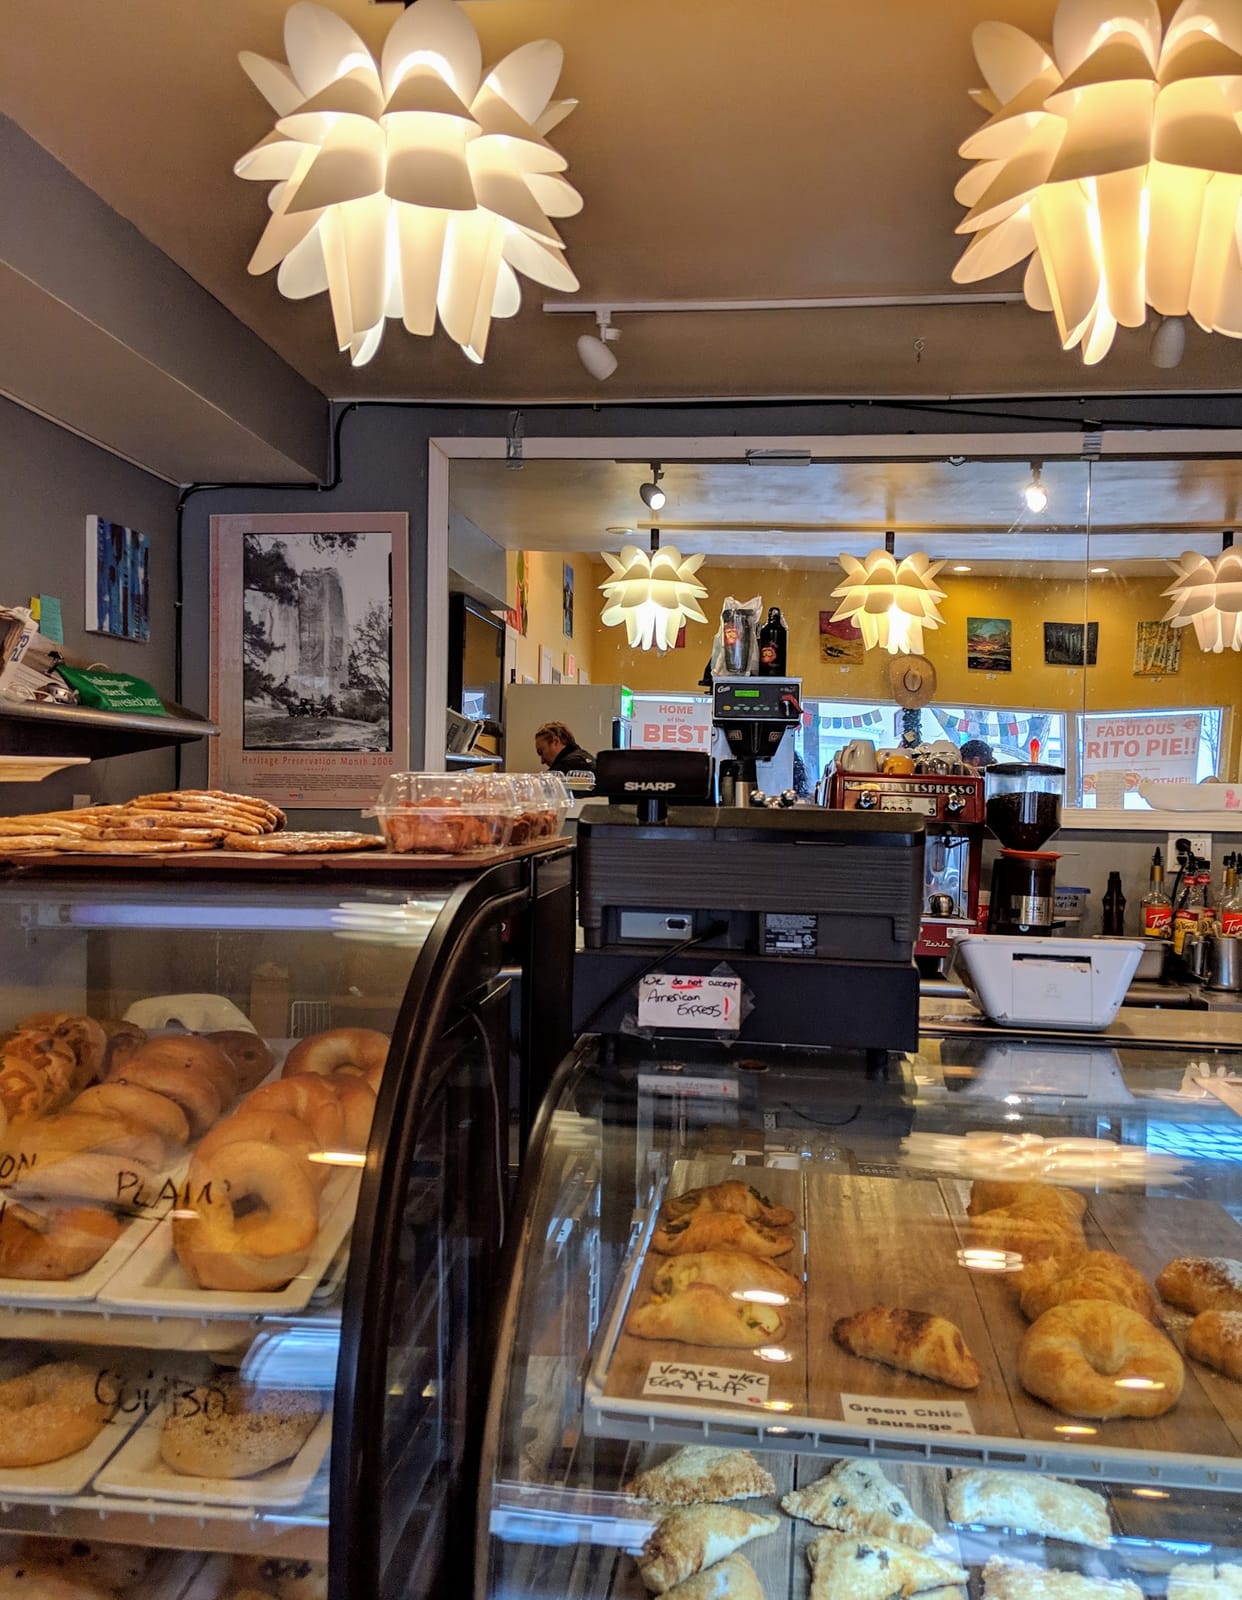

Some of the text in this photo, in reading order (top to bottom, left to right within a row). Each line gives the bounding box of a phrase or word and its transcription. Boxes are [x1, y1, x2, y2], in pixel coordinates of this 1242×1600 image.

[659, 705, 694, 714] HOME
[643, 724, 709, 743] BEST
[1097, 723, 1176, 737] FABULOUS
[1087, 737, 1197, 758] RITO PIE!!
[242, 756, 394, 767] Heritage Preservation Month 2006
[624, 782, 676, 791] SHARP
[643, 976, 665, 986] We
[708, 980, 738, 990] accept
[648, 989, 700, 1002] American
[848, 1403, 963, 1418] Green Chile
[866, 1417, 952, 1431] Sausage
